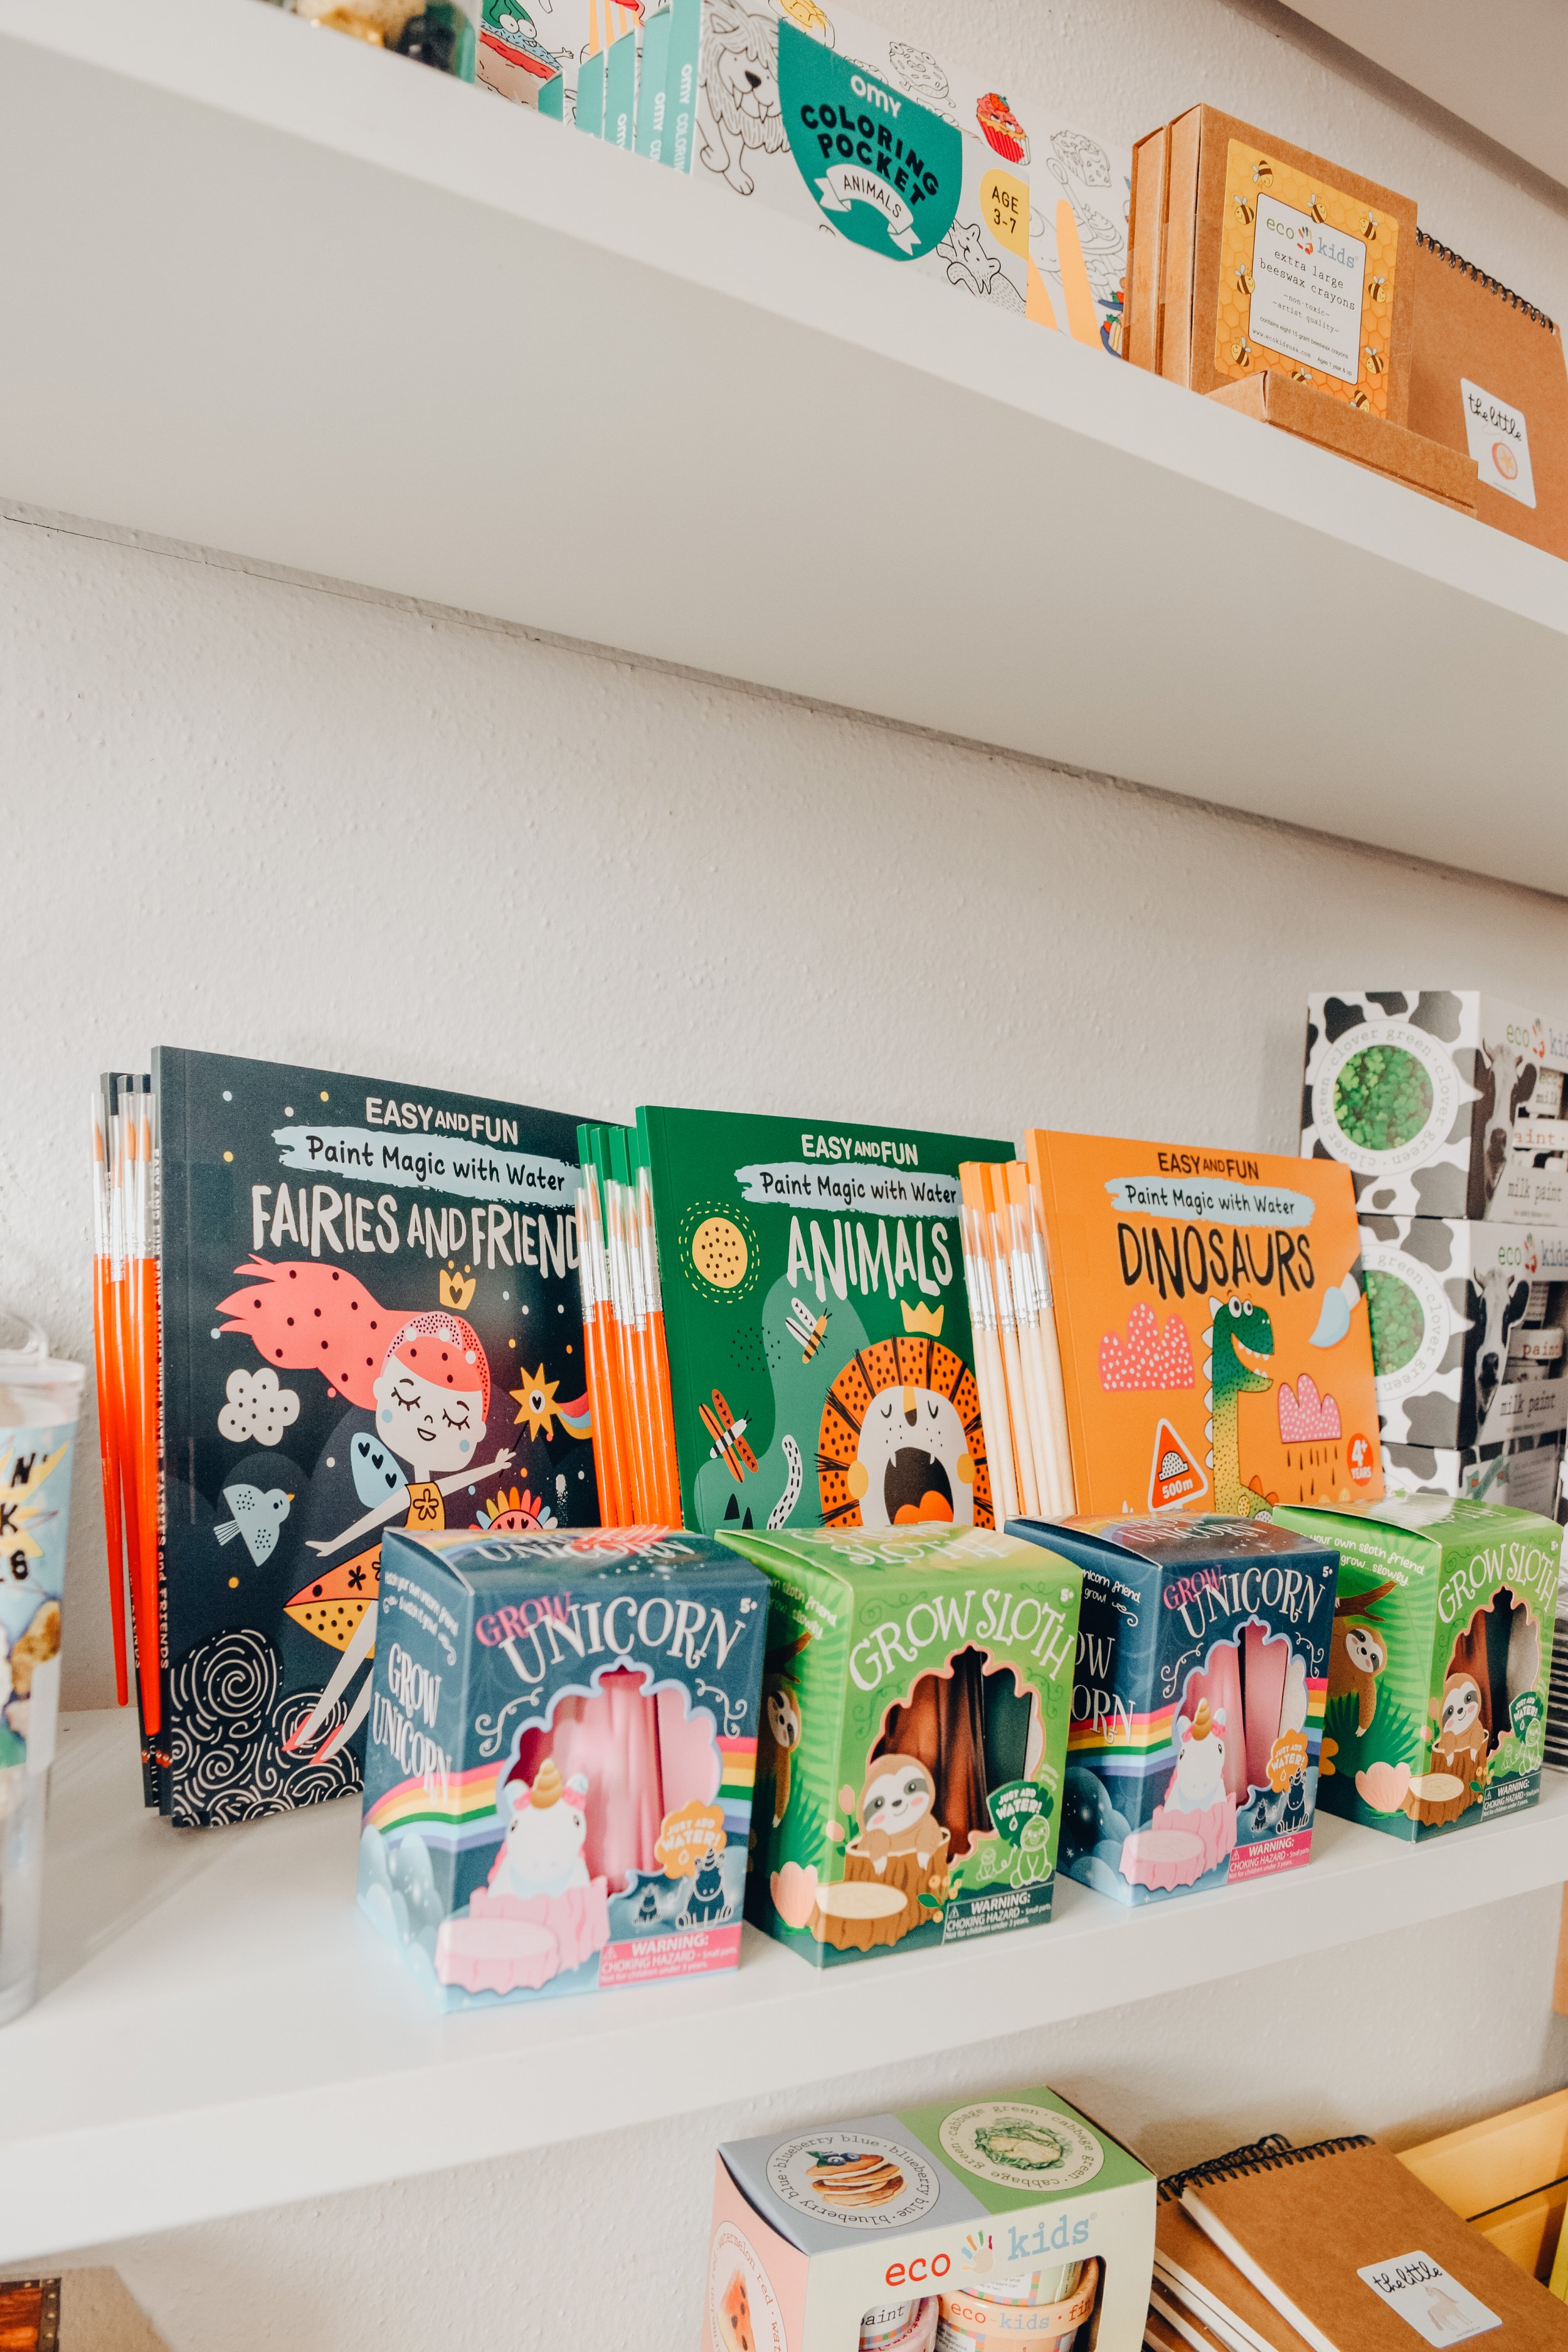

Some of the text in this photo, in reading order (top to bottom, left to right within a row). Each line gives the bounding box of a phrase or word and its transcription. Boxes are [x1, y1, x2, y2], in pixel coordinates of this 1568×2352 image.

[801, 105, 939, 196] COLORING
[817, 134, 926, 205] POCKET
[844, 175, 901, 217] ANIMALS
[992, 186, 1019, 215] AGE
[993, 208, 1016, 233] 3-7
[1266, 218, 1355, 268] eco kids
[1260, 258, 1355, 310] beeswax crayons
[1274, 251, 1343, 289] extra large
[1260, 317, 1279, 328] contains
[1280, 326, 1291, 334] eight
[1299, 334, 1310, 344] gram
[1311, 338, 1330, 351] beeswax
[1331, 347, 1348, 359] crayons
[1331, 1029, 1431, 1064] clover green
[1507, 1024, 1530, 1047] eco
[366, 1096, 518, 1145] EASY AND FUN
[1320, 1075, 1375, 1167] clover green
[1393, 1065, 1450, 1165] clover green
[306, 1135, 565, 1191] Paint Magic with Water
[802, 1134, 918, 1165] EASY AND FUN
[1158, 1152, 1259, 1180] EASY AND FUN
[760, 1172, 956, 1205] Paint Magic with Water
[1125, 1185, 1295, 1215] Paint Magic with Water
[252, 1182, 400, 1257] FAIRIES
[406, 1204, 467, 1258] AND
[787, 1216, 953, 1303] ANIMALS
[1118, 1222, 1315, 1300] DINOSAURS
[1498, 1247, 1522, 1266] eco
[1426, 1292, 1442, 1359] clover
[1352, 1439, 1368, 1466] 4+
[1162, 1478, 1193, 1500] 500m
[1351, 1466, 1372, 1479] YEARS
[1115, 1523, 1267, 1542] UNICORN
[476, 1540, 695, 1562] UNICORN
[830, 1539, 1009, 1565] SLOTH
[1335, 1538, 1425, 1576] own sloth friend
[1084, 1588, 1106, 1603] grow!
[1162, 1565, 1222, 1610] GROW
[1438, 1542, 1557, 1623] GROW SLOTH
[475, 1591, 572, 1646] GROW
[1177, 1567, 1326, 1638] UNICORN
[159, 1587, 169, 1669] FRIENDS
[498, 1596, 746, 1683] UNICORN
[849, 1589, 1075, 1692] GROW SLOTH
[388, 1642, 442, 1729] GROW
[1513, 1705, 1539, 1722] WATER!
[1515, 1699, 1527, 1710] JUST
[372, 1691, 452, 1807] UNICORN
[1270, 1753, 1305, 1772] WATER!
[1275, 1744, 1302, 1757] JUST ADD
[999, 1788, 1037, 1805] JUST ADD
[1484, 1791, 1523, 1810] CHOKING HAZARD
[1498, 1779, 1529, 1797] WARNING:
[995, 1798, 1042, 1820] WATER!
[662, 1830, 721, 1852] WATER!
[1249, 1837, 1294, 1857] WARNING:
[1230, 1858, 1259, 1872] CHOKING
[1260, 1851, 1286, 1865] HAZARD
[946, 1907, 1020, 1932] CHOKING HAZARD
[971, 1891, 1031, 1915] WARNING:
[632, 1933, 709, 1956] WARNING:
[652, 1949, 696, 1966] HAZARD
[948, 2106, 1039, 2136] cabbage green
[773, 2135, 879, 2168] blueberry blue
[1051, 2116, 1094, 2180] cabbage green
[889, 2146, 930, 2217] blueberry blue
[951, 2143, 1059, 2188] cabbage green
[778, 2174, 892, 2225] blueberry blue
[885, 2214, 1090, 2287] eco kids
[757, 2273, 773, 2305] red
